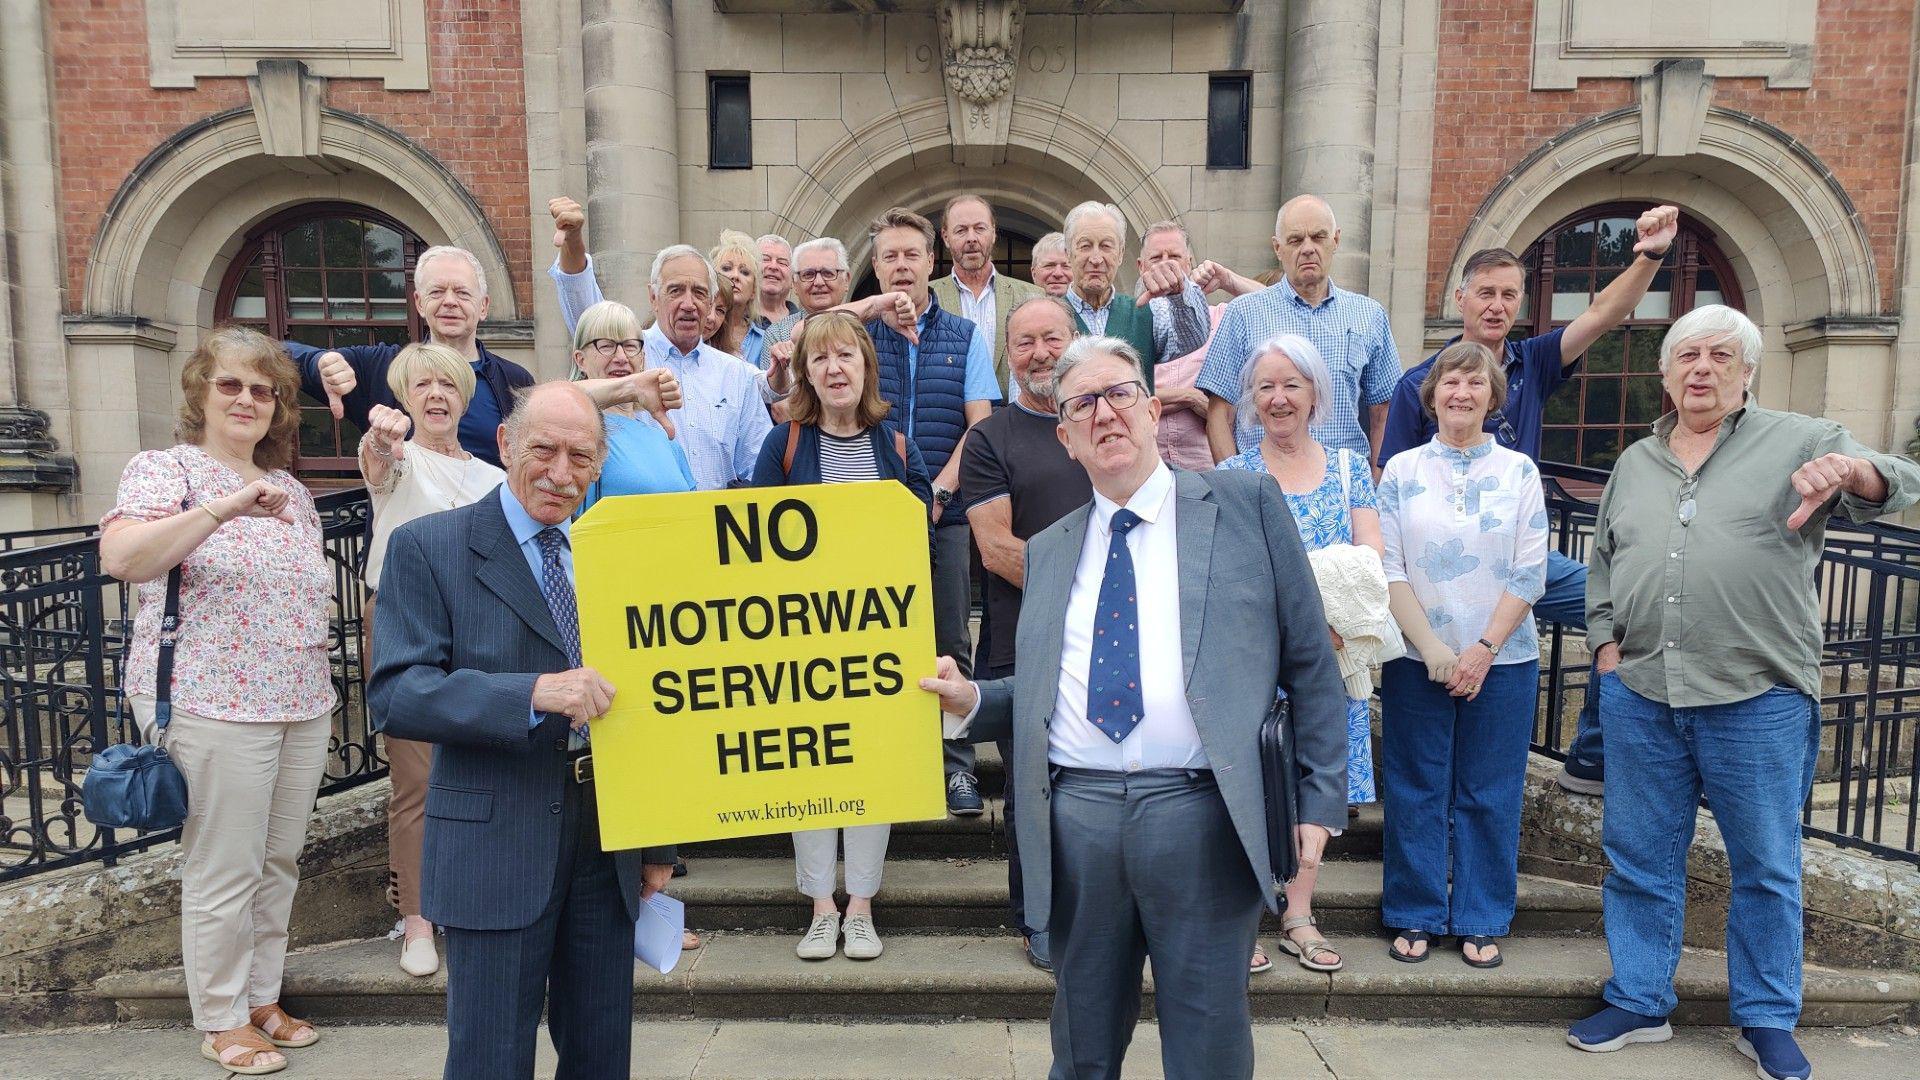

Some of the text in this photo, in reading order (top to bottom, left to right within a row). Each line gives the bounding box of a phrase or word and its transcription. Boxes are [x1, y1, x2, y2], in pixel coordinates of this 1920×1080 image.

[904, 44, 932, 74] 19
[714, 498, 819, 565] NO
[625, 584, 917, 650] MOTORWAY
[651, 652, 904, 715] SERVICES
[716, 722, 854, 775] HERE
[716, 797, 866, 824] www.kirbyhill.org
